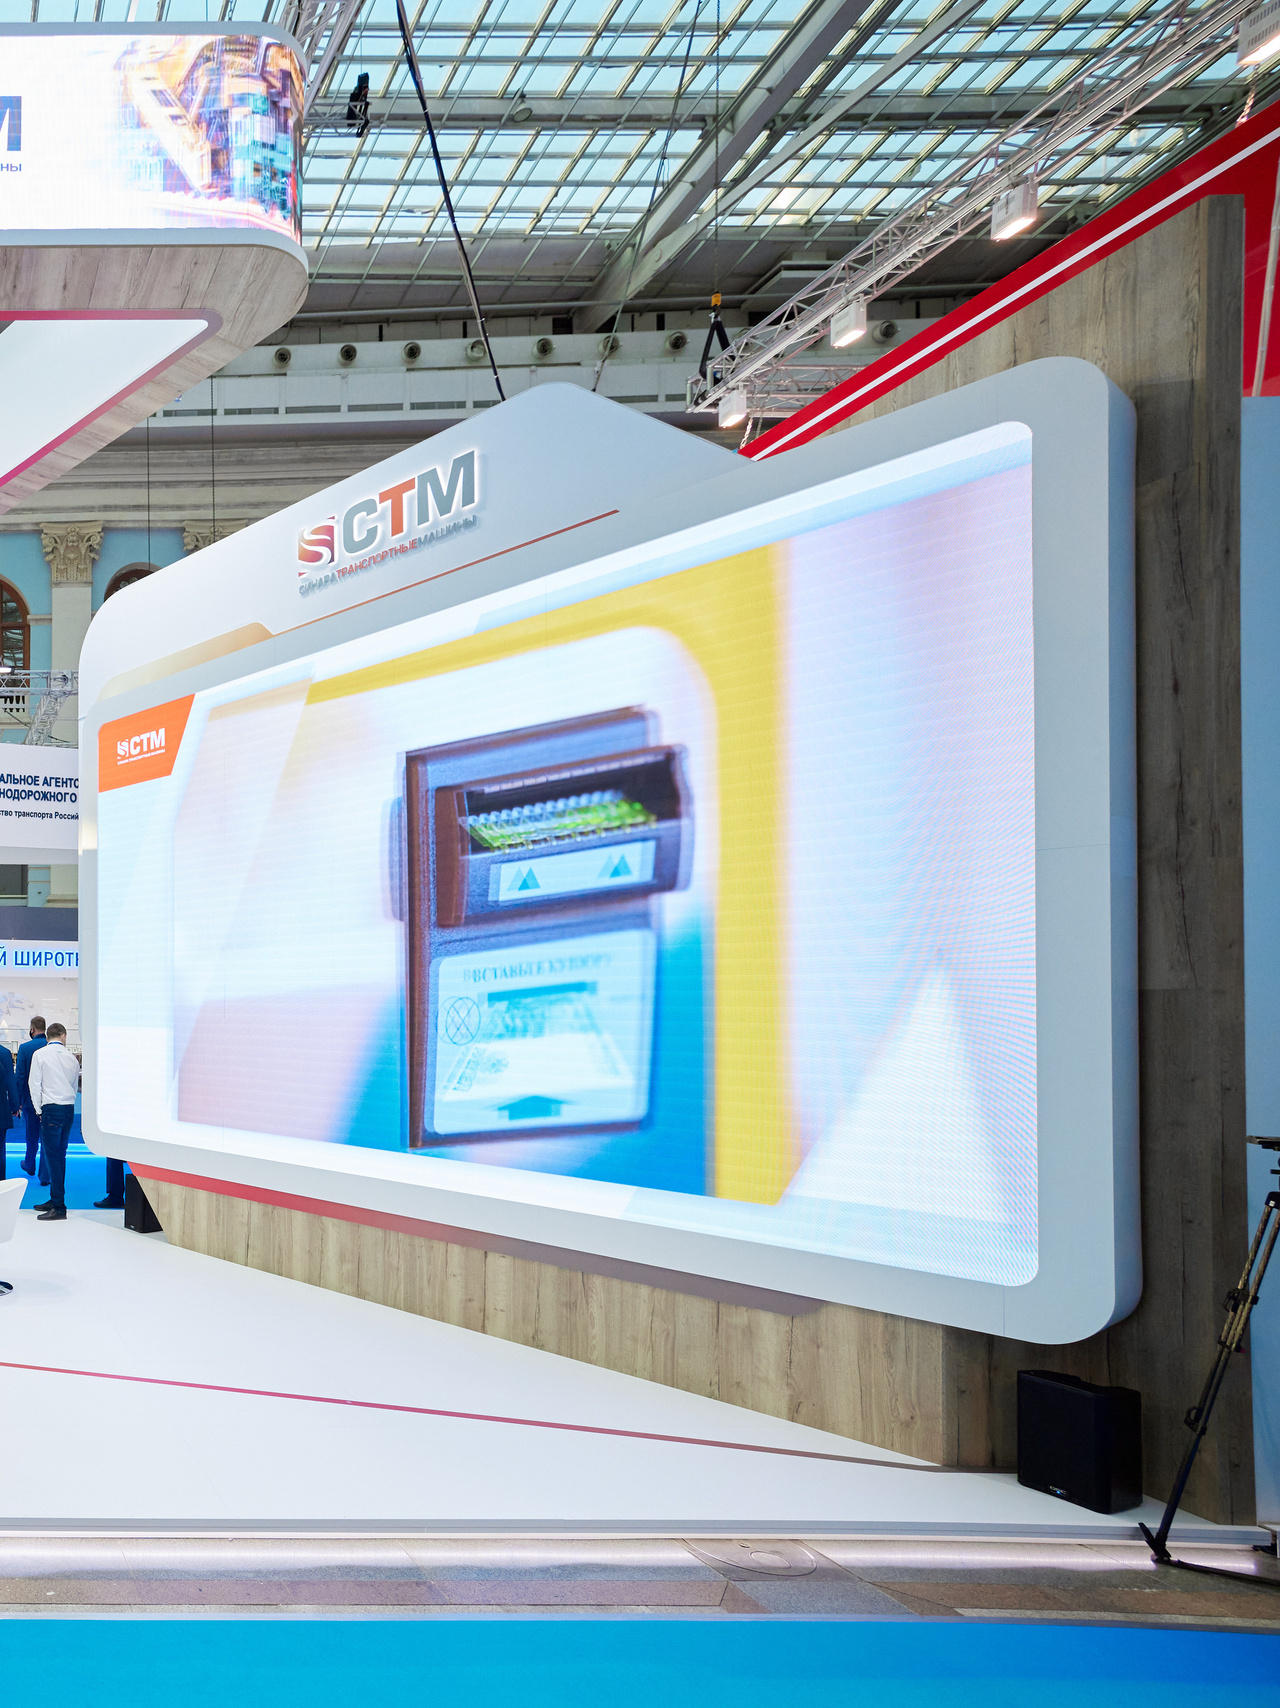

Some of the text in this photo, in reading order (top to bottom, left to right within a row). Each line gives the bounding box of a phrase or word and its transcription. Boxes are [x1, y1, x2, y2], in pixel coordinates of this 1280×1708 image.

[342, 449, 476, 554] СТМ
[129, 728, 165, 755] СТМ
[42, 776, 79, 788] АГЕНТС
[14, 810, 53, 820] транспорта
